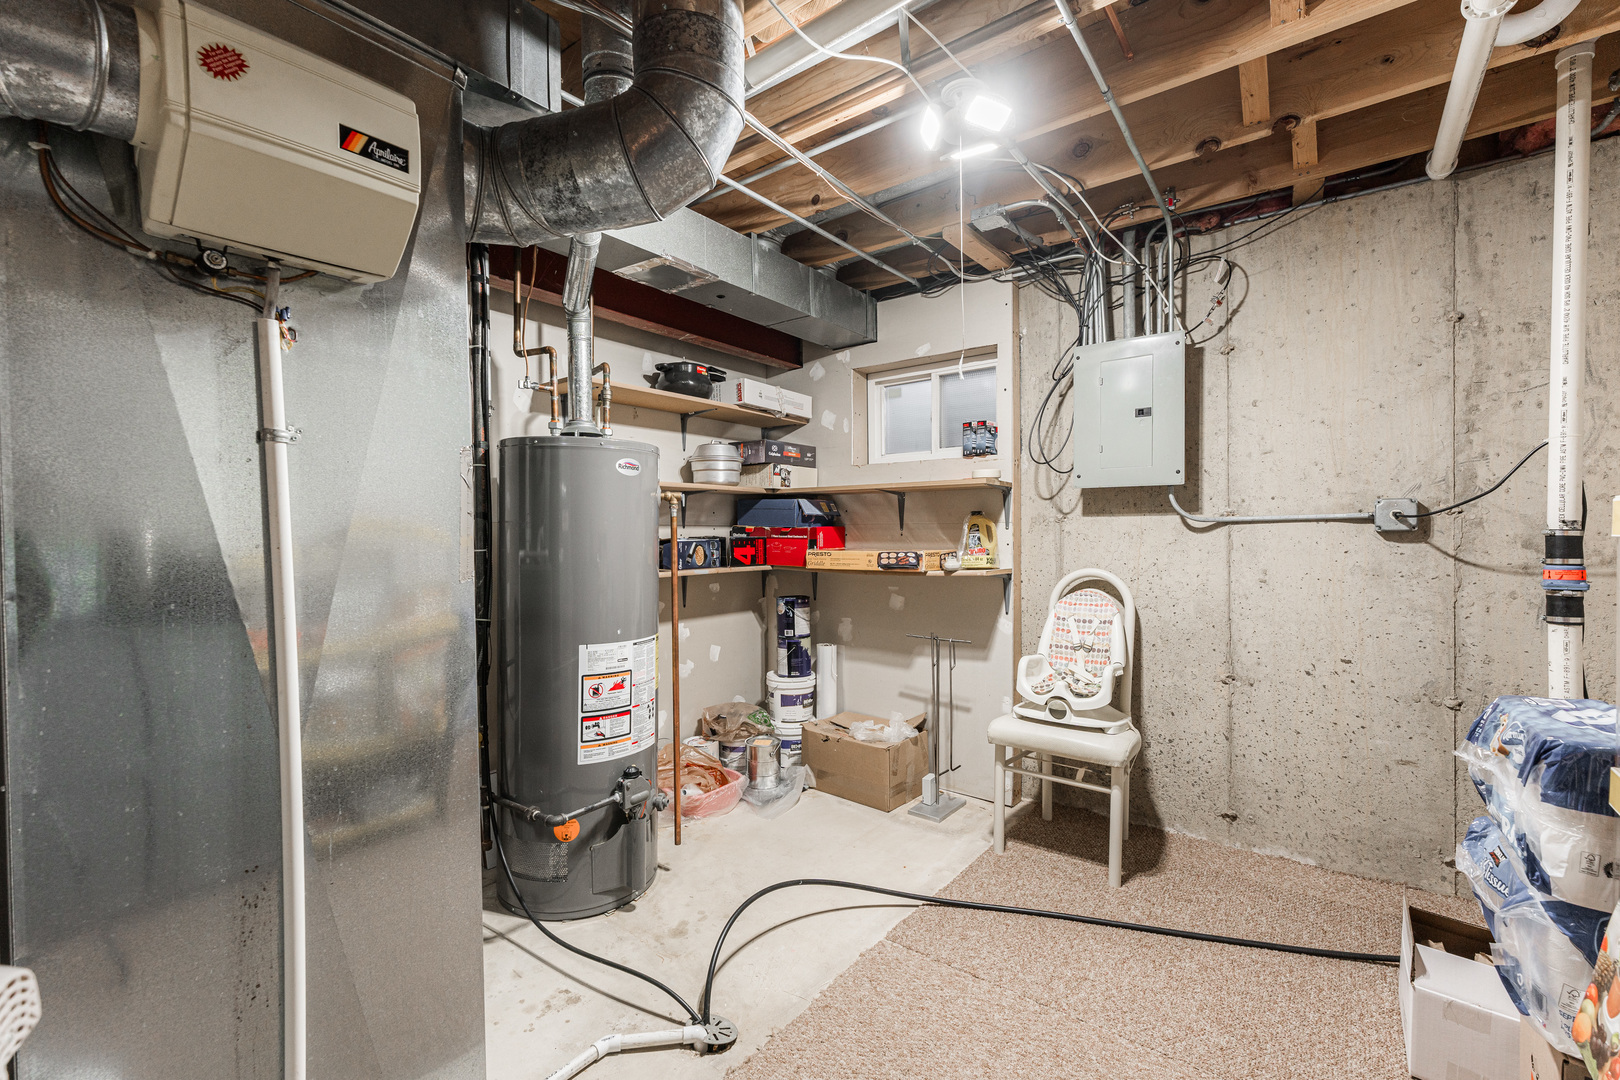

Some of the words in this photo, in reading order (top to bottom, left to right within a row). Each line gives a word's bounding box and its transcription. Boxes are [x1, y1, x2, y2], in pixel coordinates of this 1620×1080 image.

[368, 141, 406, 166] Aprilaire
[1564, 254, 1572, 273] CELLULAR
[618, 463, 639, 471] Richmond
[734, 545, 755, 566] 4
